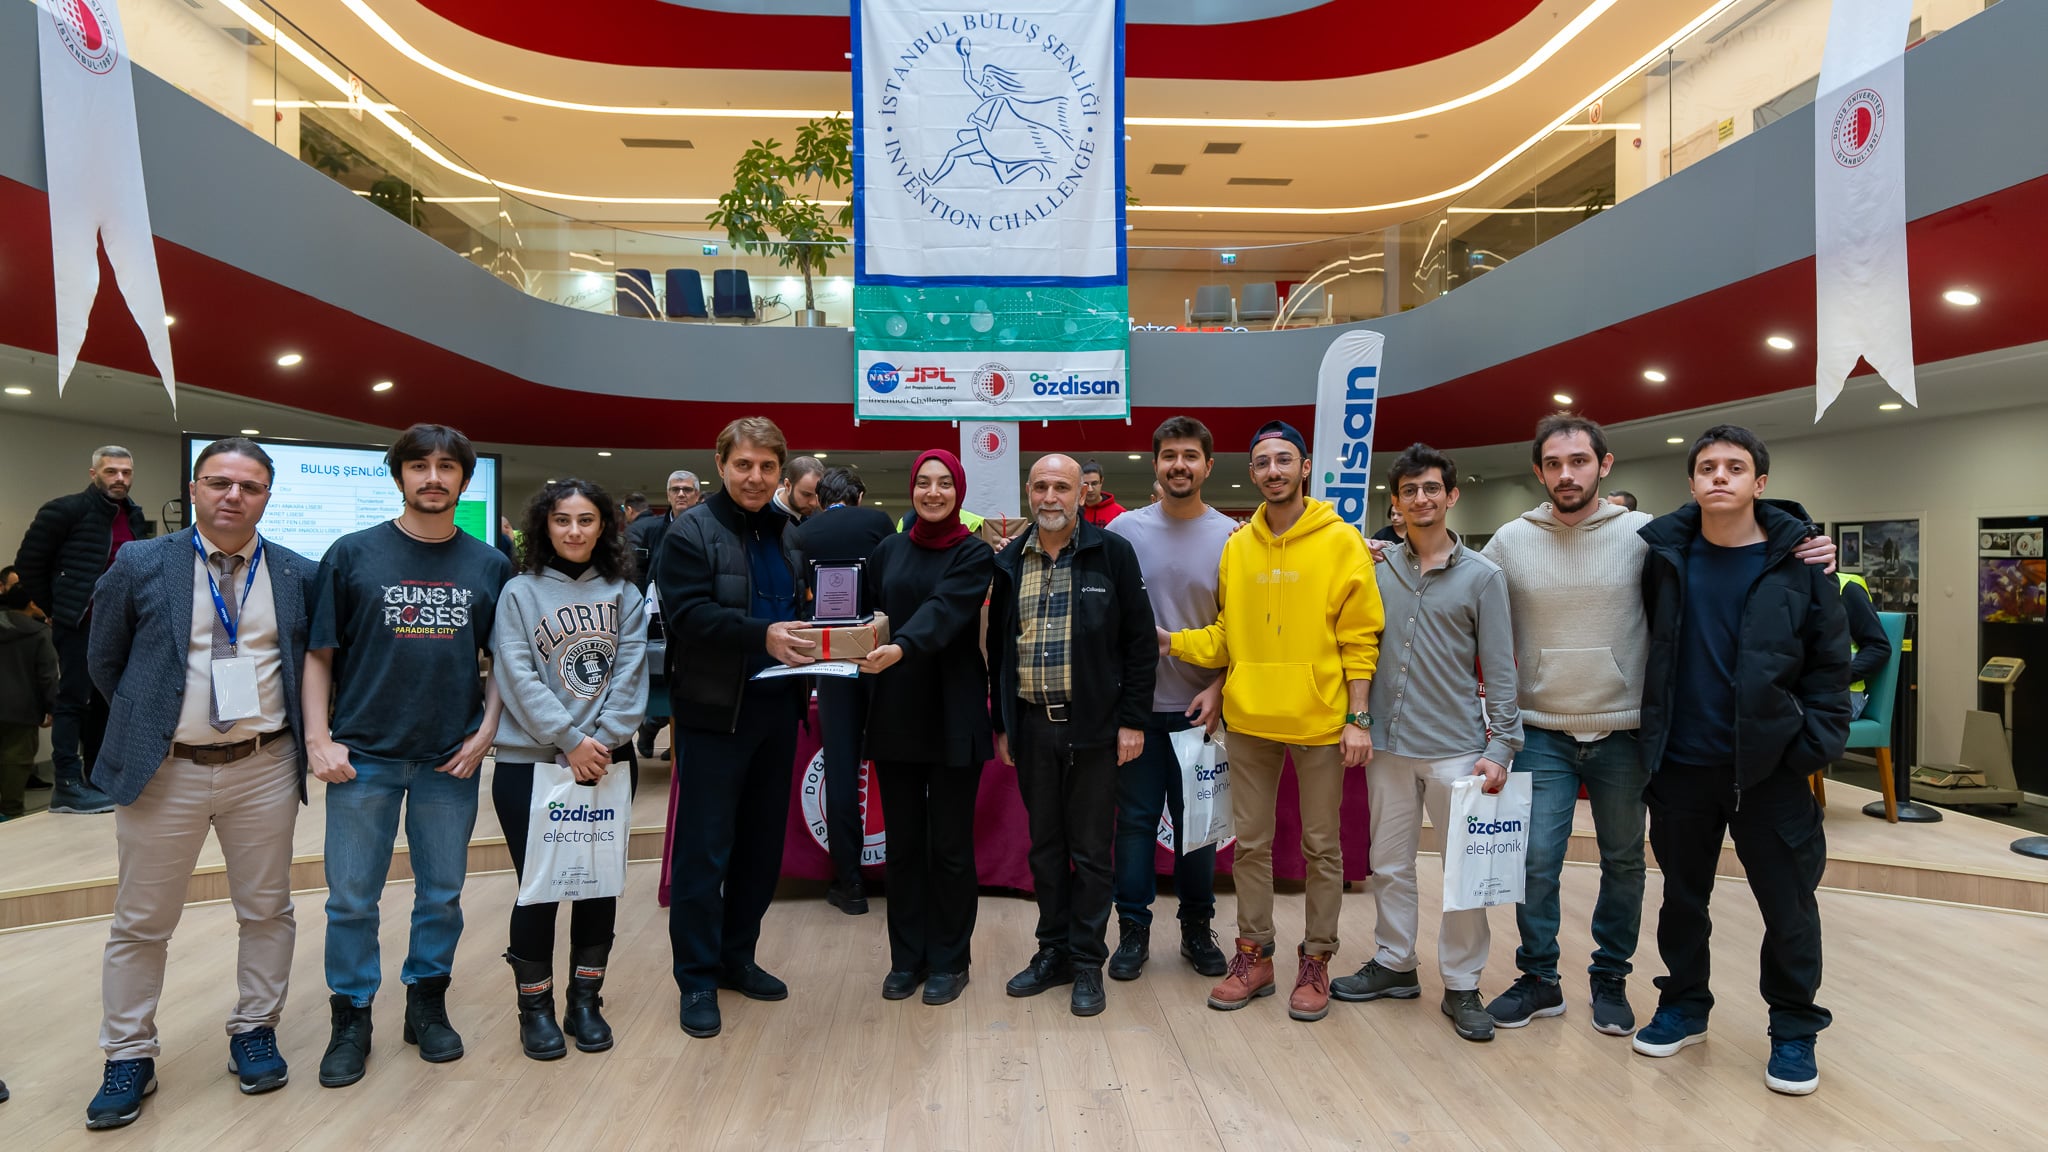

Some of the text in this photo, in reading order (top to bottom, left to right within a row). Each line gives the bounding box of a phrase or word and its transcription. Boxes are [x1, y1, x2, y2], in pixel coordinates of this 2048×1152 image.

[878, 13, 1101, 117] İSTANBUL BULUŞ ŞENLİĞİ
[884, 138, 1095, 232] INVENTION CHALLENGE
[869, 372, 898, 383] NASA
[905, 366, 956, 383] JPL
[1029, 372, 1120, 396] özdisan
[1325, 366, 1377, 530] disan
[301, 463, 388, 478] BULUŞ ŞENLİĞİ
[381, 584, 450, 605] GUNS
[382, 604, 471, 627] ROSES
[534, 601, 618, 664] FLORID
[804, 754, 825, 796] DOĞ
[1195, 761, 1229, 782] özan
[548, 801, 615, 823] özdisan
[543, 828, 615, 843] electronics
[1467, 815, 1522, 835] özdsan
[1466, 839, 1522, 855] elekronik
